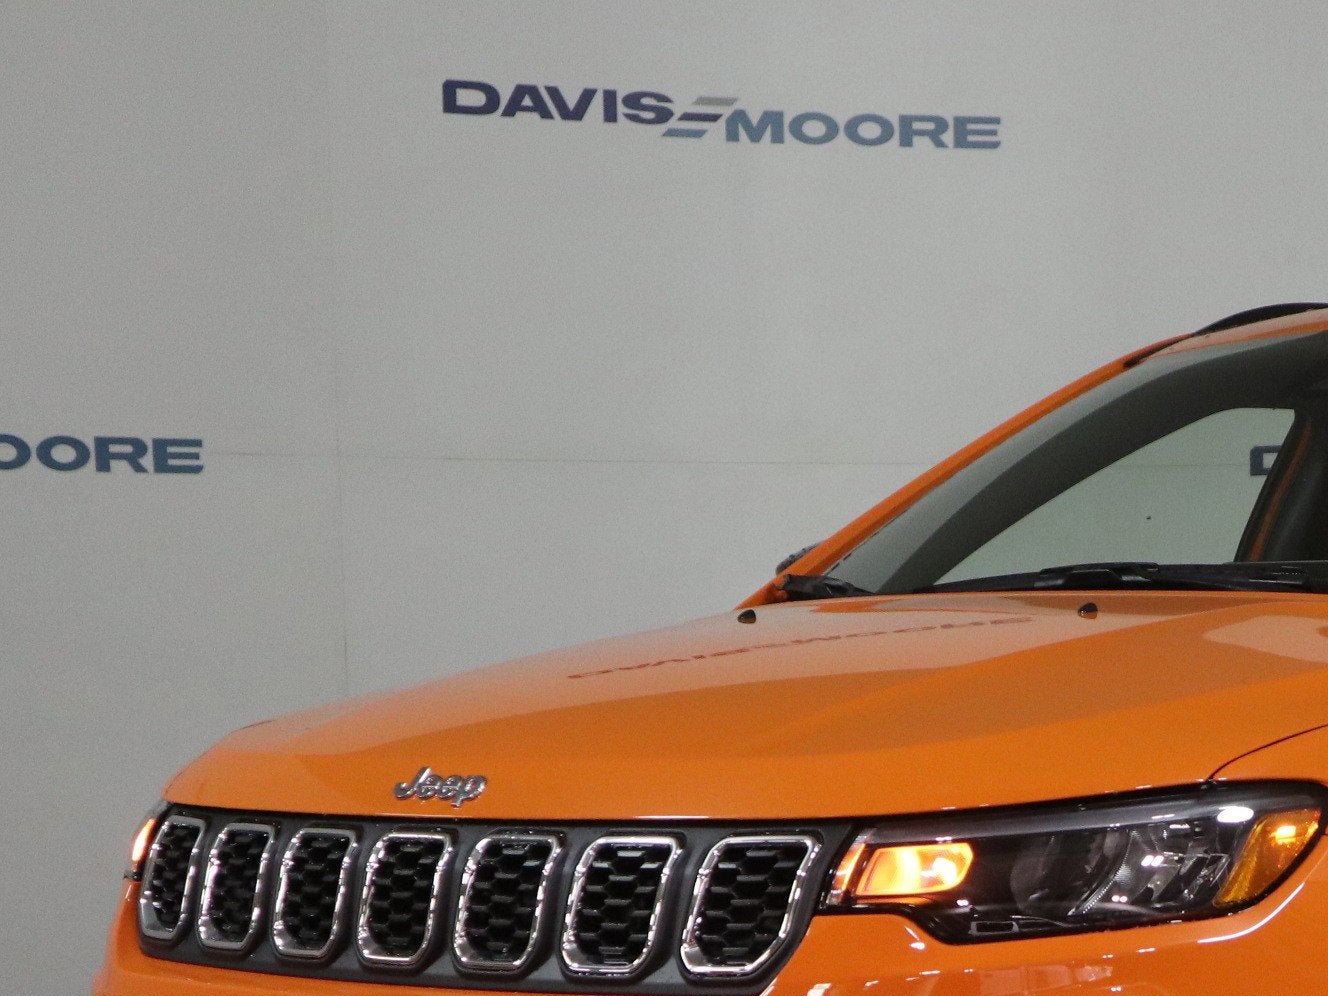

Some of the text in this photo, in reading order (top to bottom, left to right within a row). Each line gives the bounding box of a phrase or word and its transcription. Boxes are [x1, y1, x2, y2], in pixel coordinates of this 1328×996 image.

[442, 79, 1001, 149] DAVIS MOORE
[393, 766, 487, 807] Jeep
